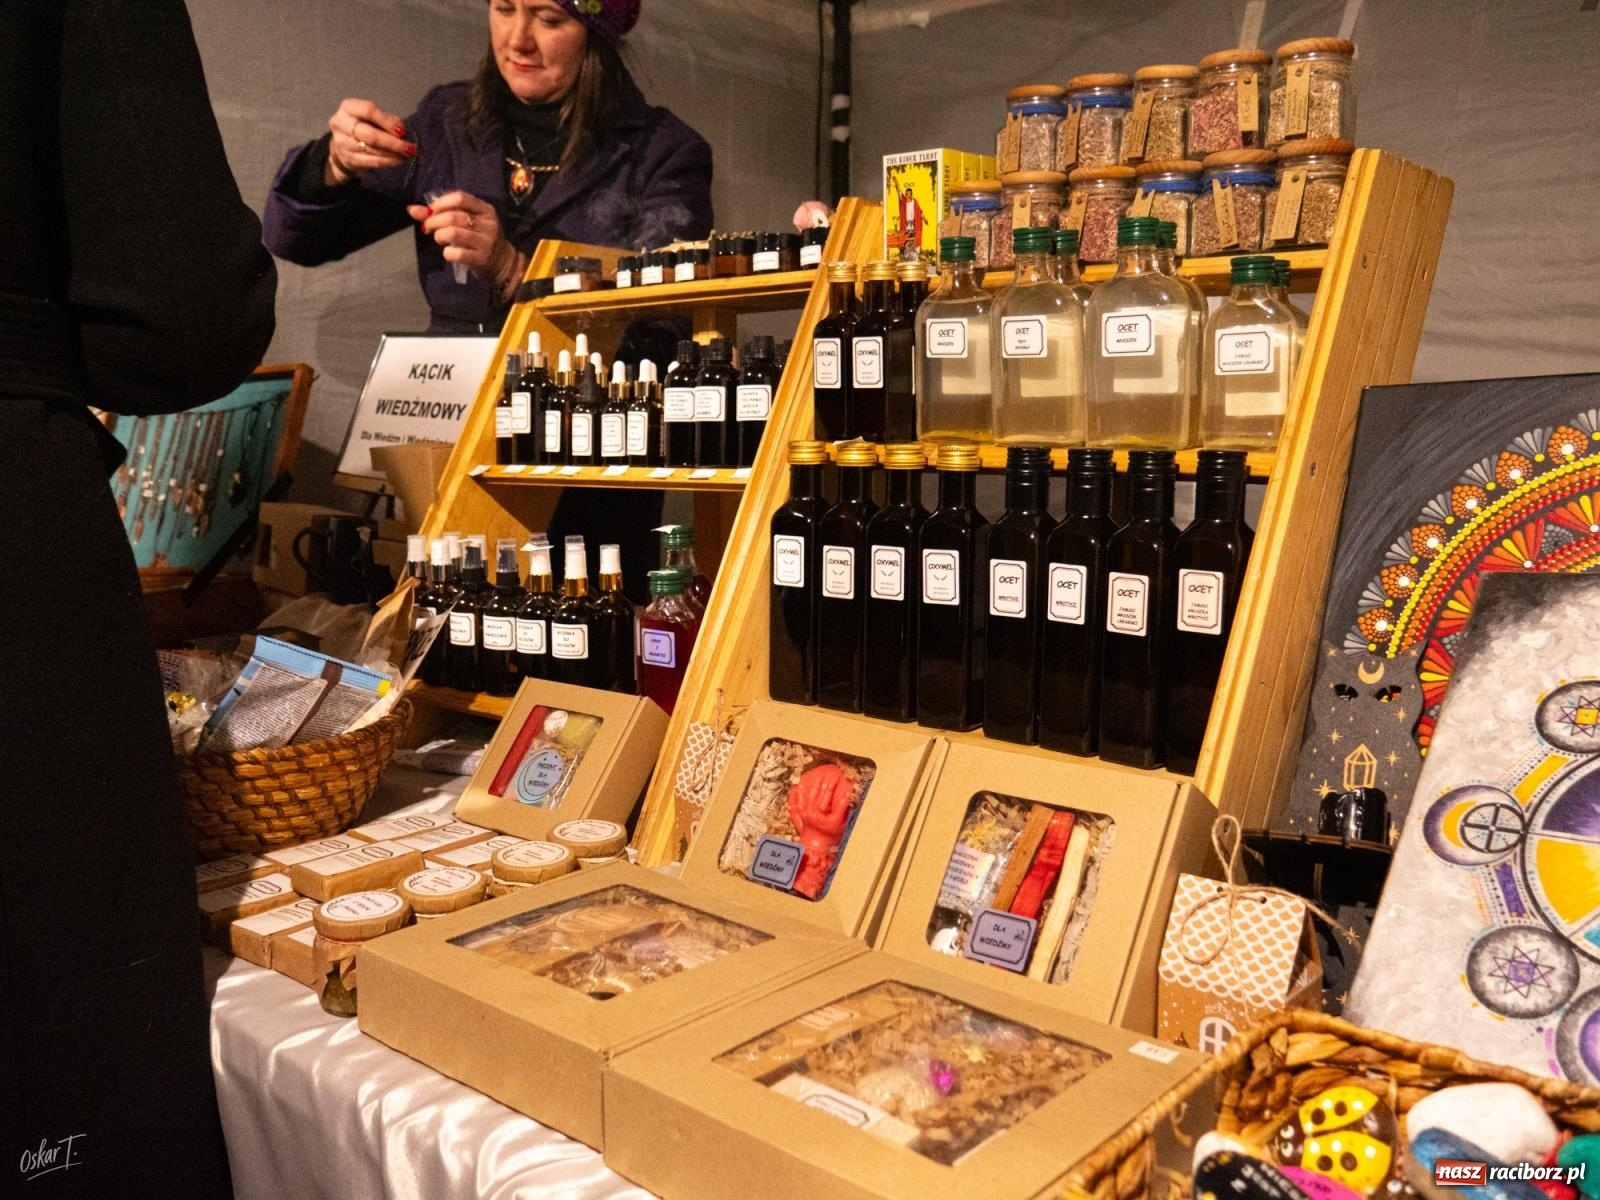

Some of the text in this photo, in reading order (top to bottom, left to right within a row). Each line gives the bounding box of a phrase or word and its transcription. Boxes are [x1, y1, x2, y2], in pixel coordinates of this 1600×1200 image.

[919, 152, 938, 161] TAROT
[1015, 327, 1031, 336] OCET
[1117, 323, 1139, 333] OCET
[938, 329, 957, 337] OCET
[1235, 340, 1254, 349] OCET
[408, 363, 455, 384] KĄCIK
[375, 396, 468, 421] WIEDŹMOWY
[778, 548, 801, 556] OXYMEL
[828, 558, 850, 566] OXYMEL
[876, 558, 901, 567] OXYMEL
[928, 563, 955, 571] OXYMEL
[999, 576, 1020, 585] OCET
[1057, 580, 1079, 590] OCET
[1117, 589, 1140, 598] OCET
[1188, 584, 1213, 594] OCET
[770, 850, 782, 858] DLA
[992, 923, 1007, 933] DLA
[979, 935, 1013, 951] WIEDŹMY
